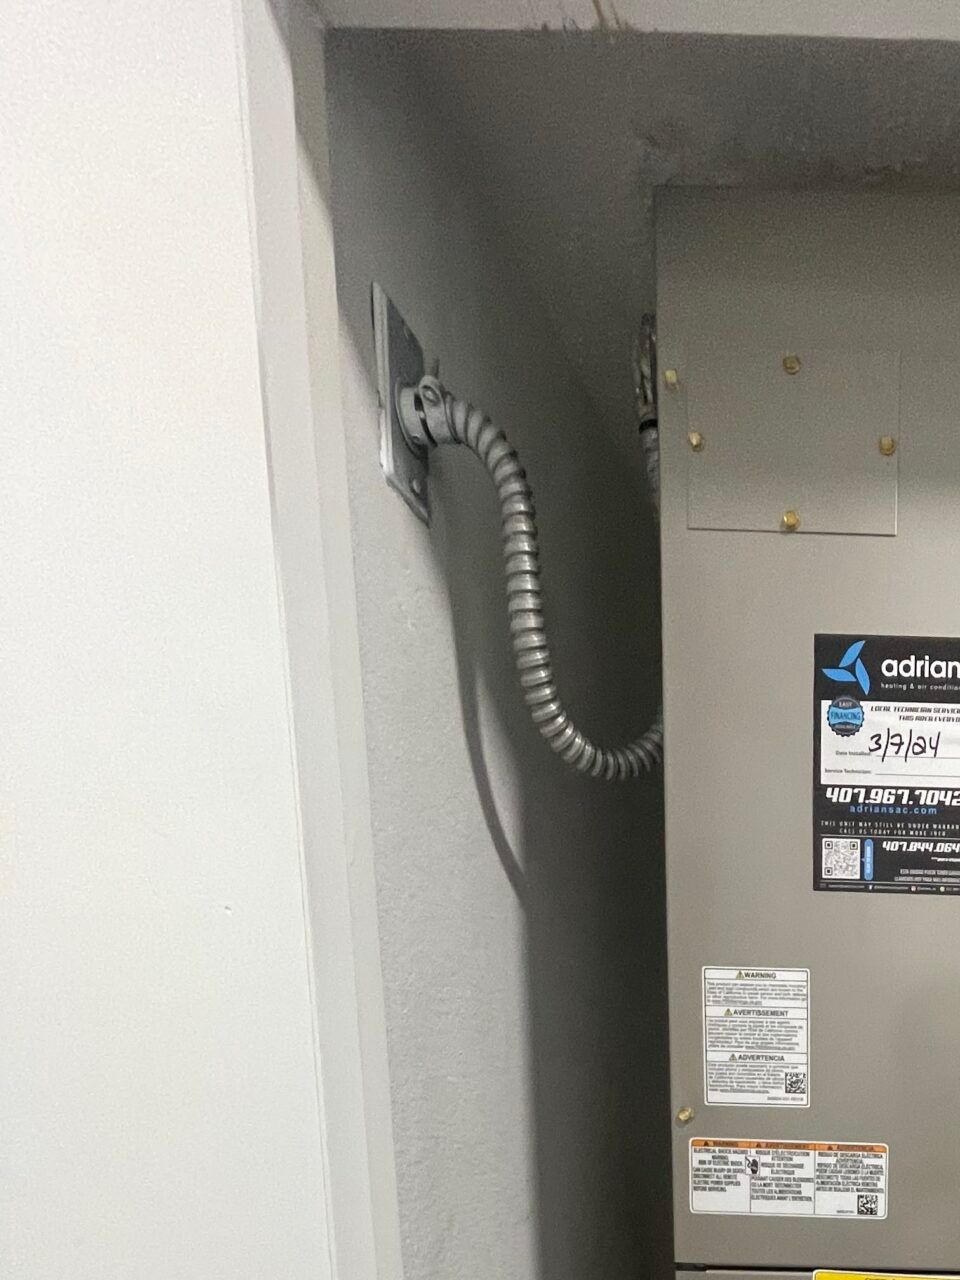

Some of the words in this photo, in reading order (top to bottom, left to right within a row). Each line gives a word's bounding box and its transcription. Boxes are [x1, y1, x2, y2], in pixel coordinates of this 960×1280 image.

[880, 682, 907, 691] heating
[870, 705, 891, 713] LOCAL
[893, 706, 932, 714] TECHNICIAN
[830, 711, 861, 721] FINANCING
[868, 727, 941, 762] 3/7/24
[849, 805, 937, 815] adriansac.com
[743, 972, 777, 980] WARNING
[732, 1009, 789, 1018] AVERTISSEMENT
[737, 1054, 785, 1062] ADVERTENCIA
